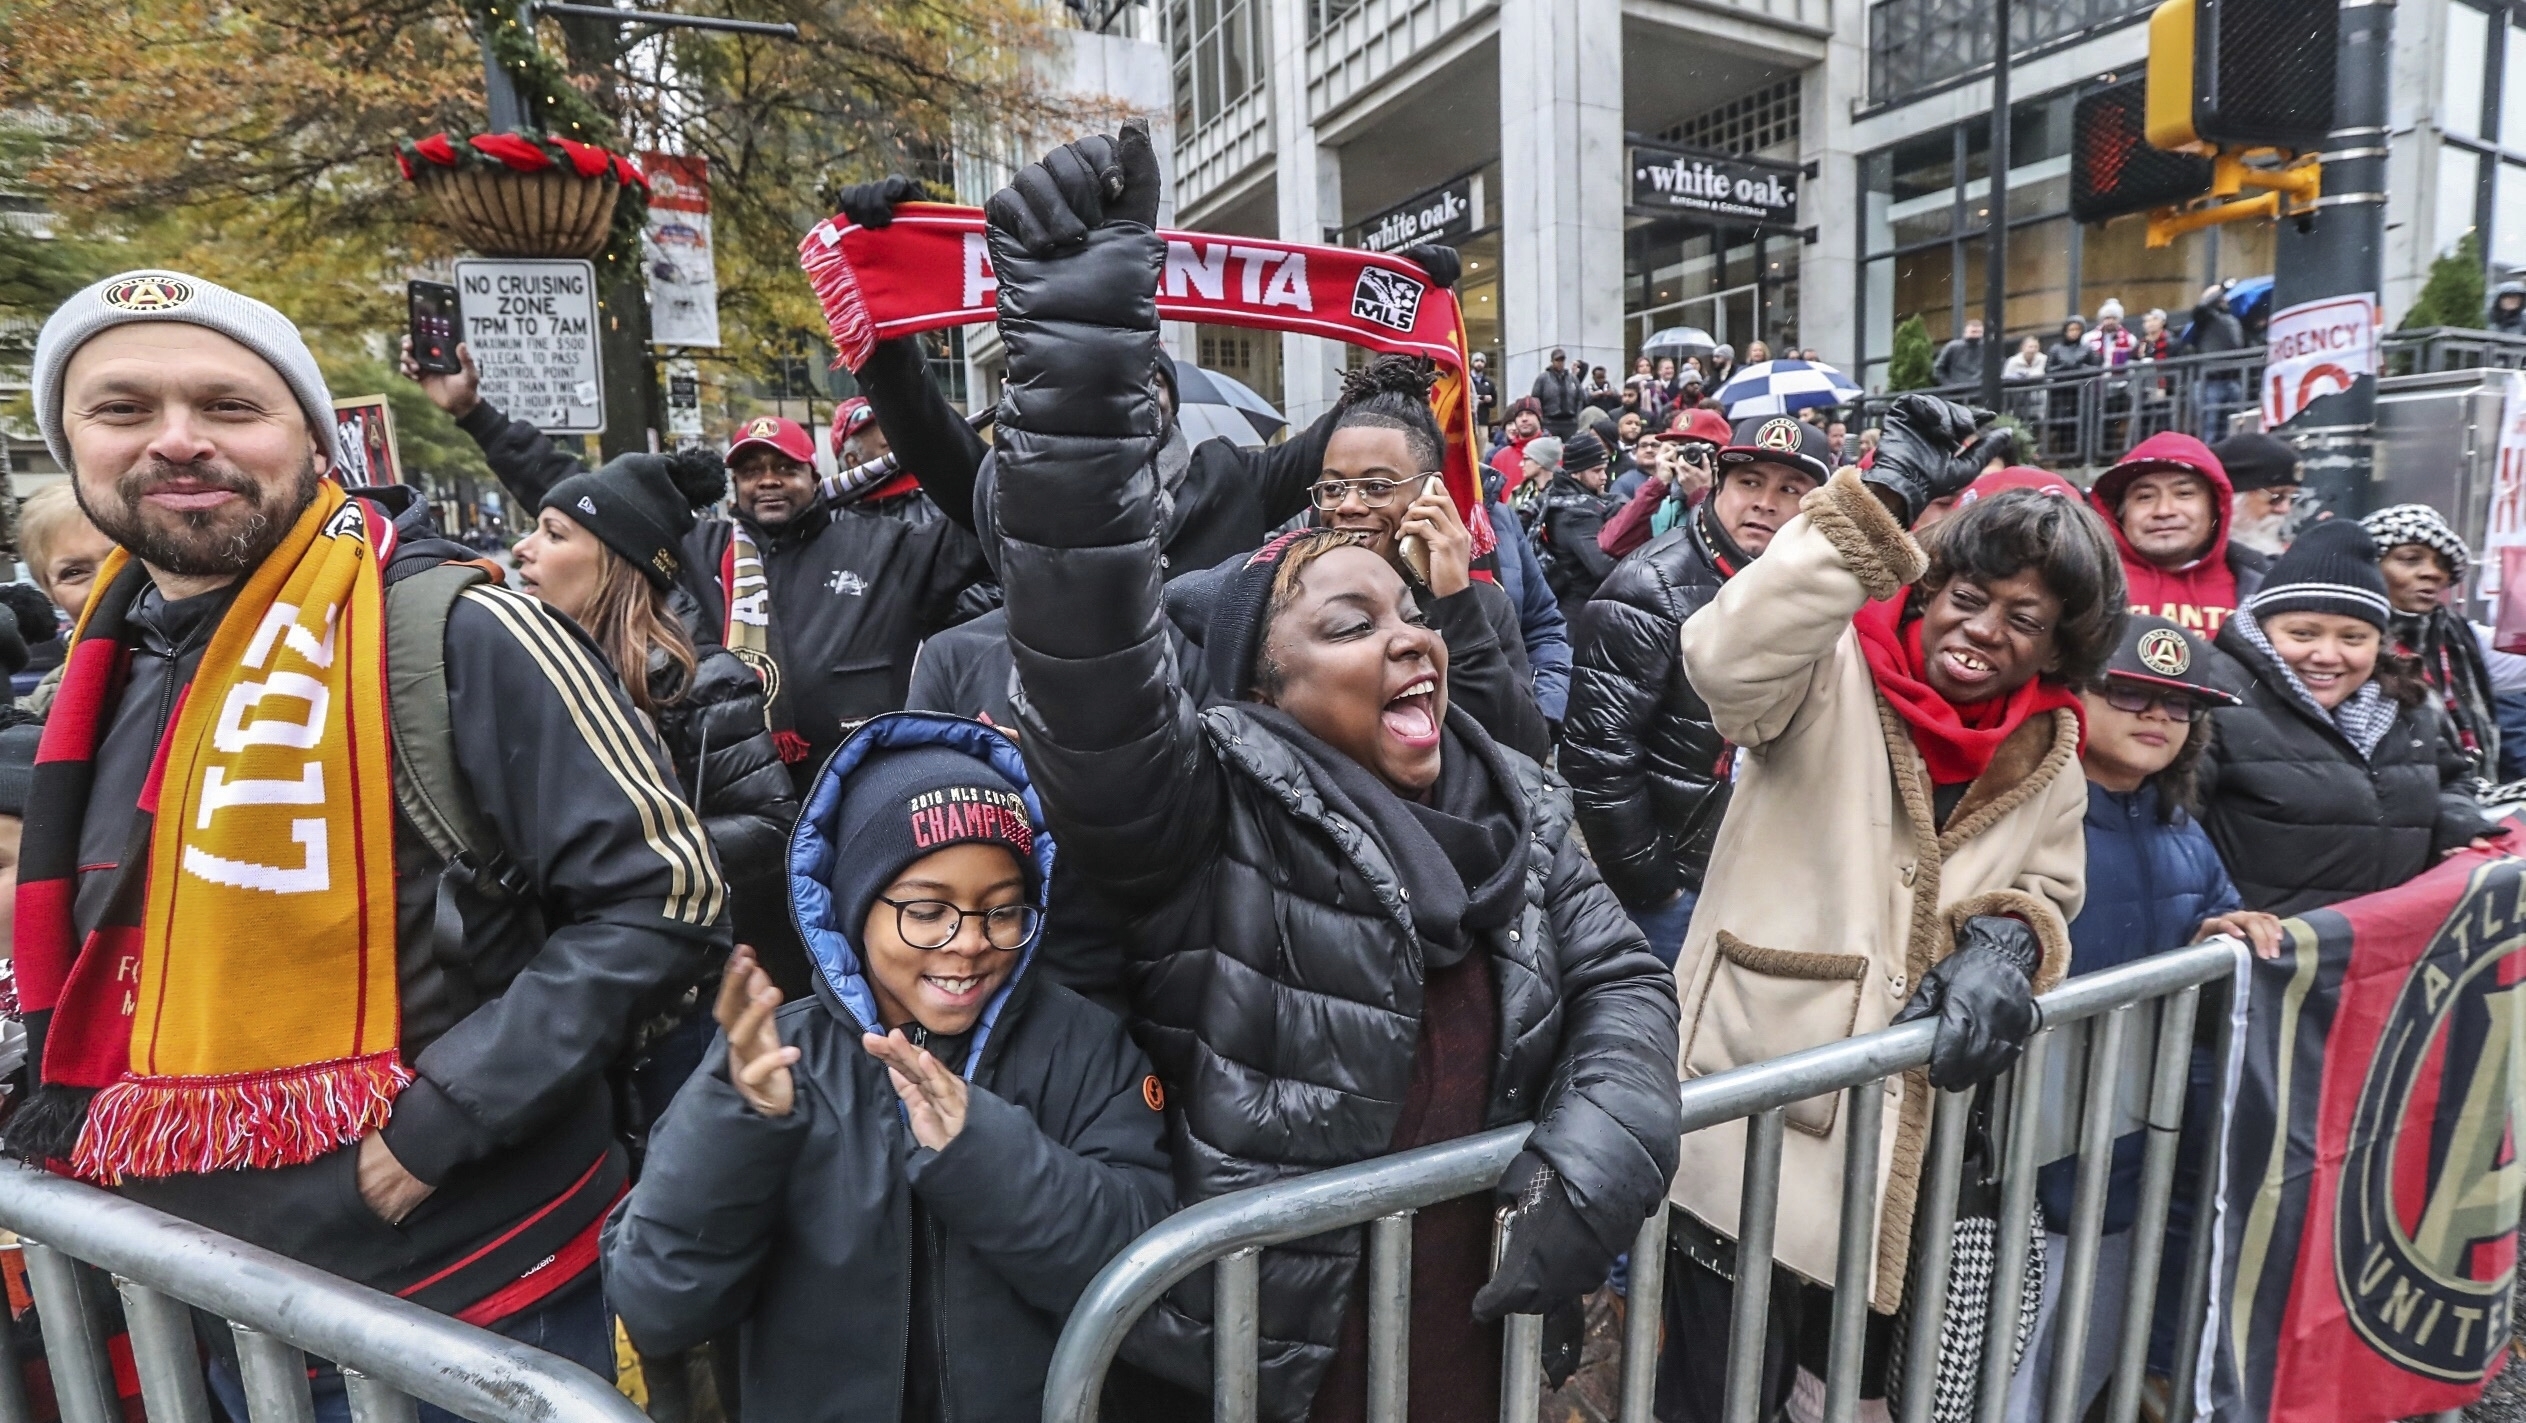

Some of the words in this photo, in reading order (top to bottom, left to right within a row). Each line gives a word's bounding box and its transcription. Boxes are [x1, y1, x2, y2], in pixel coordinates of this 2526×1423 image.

[1648, 157, 1731, 199] white
[1734, 175, 1787, 208] oak
[1670, 195, 1710, 209] KITCHEN
[1719, 202, 1767, 217] COCKTAILS
[1367, 211, 1418, 251] white
[1420, 190, 1460, 231] oak
[963, 232, 1313, 313] ANTA
[464, 276, 490, 294] NO
[497, 275, 583, 295] CRUISING
[498, 297, 557, 315] ZONE
[1354, 299, 1413, 330] MLS
[469, 317, 508, 335] 7PM
[515, 317, 537, 335] TO
[548, 317, 587, 335] 7AM
[474, 338, 521, 349] MAXIMUM
[526, 338, 548, 349] FINE
[557, 337, 586, 350] $500
[480, 352, 525, 364] ILLEGAL
[533, 352, 545, 364] TO
[551, 352, 579, 364] PASS
[484, 366, 536, 379] CONTROL
[543, 366, 575, 378] POINT
[480, 380, 509, 393] MORE
[518, 380, 546, 393] THAN
[553, 380, 583, 393] TWIC
[513, 395, 520, 407] 2
[524, 395, 551, 407] HOUR
[557, 395, 592, 408] PERI
[183, 601, 338, 895] 2017
[911, 790, 943, 812] 2018
[950, 787, 979, 801] MLS
[984, 790, 1006, 806] CUP
[2358, 1242, 2516, 1358] UNITE
